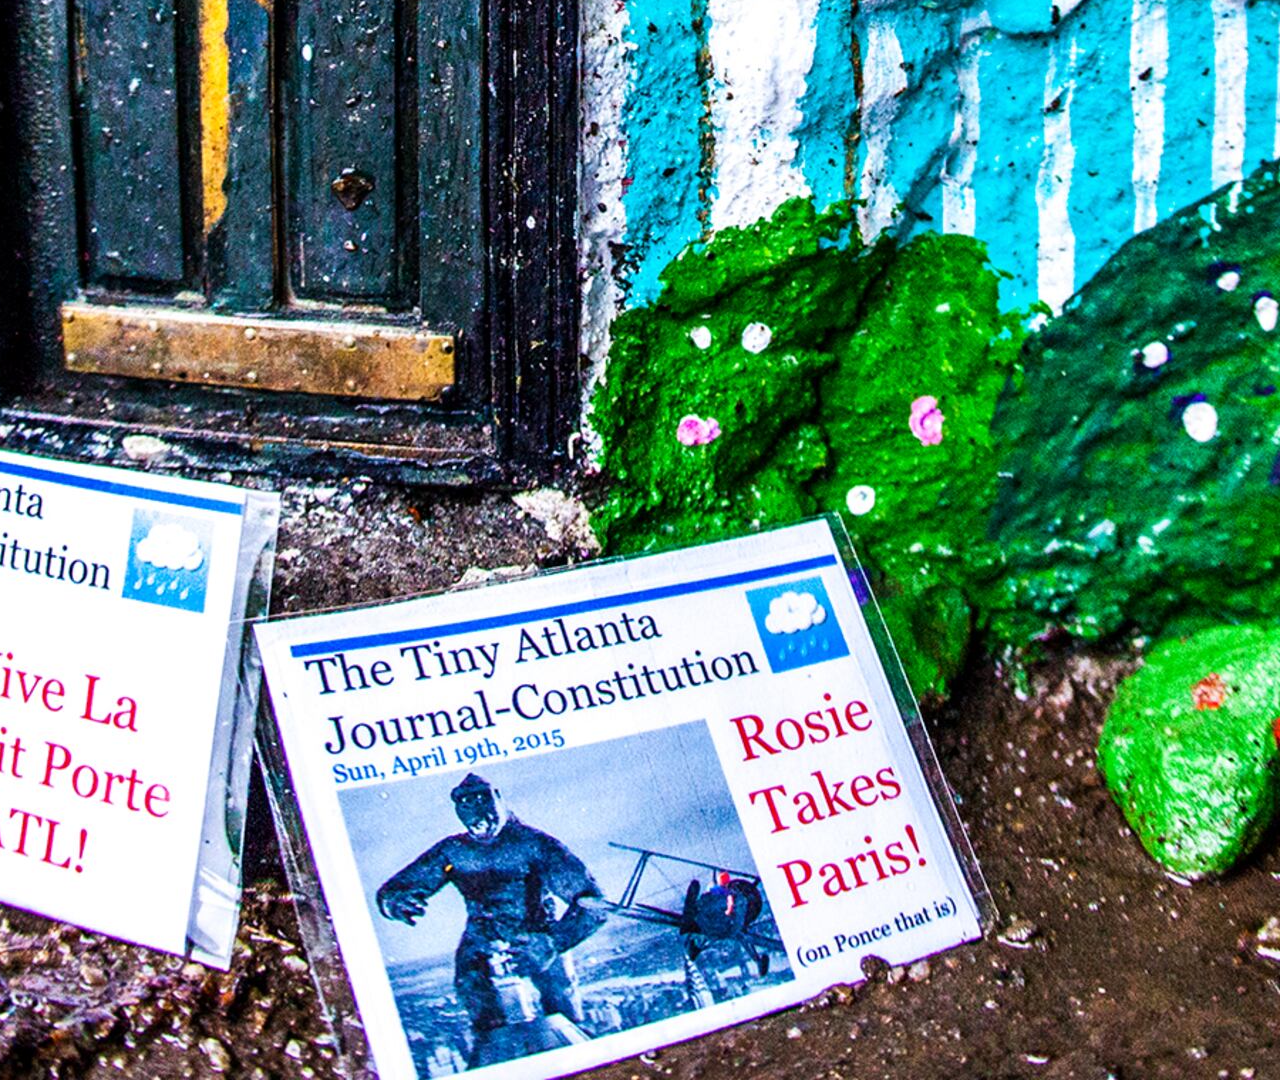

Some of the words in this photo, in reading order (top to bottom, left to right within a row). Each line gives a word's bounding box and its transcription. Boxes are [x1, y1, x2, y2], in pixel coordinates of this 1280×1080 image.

[304, 654, 395, 696] The
[400, 640, 502, 680] Tiny
[515, 609, 662, 665] Atlanta
[80, 674, 138, 732] La
[324, 649, 760, 756] Journal-Constitution
[729, 692, 874, 762] Rosie
[39, 741, 171, 818] Porte
[332, 760, 386, 784] Sun,
[392, 746, 448, 778] April
[455, 738, 509, 766] 19th,
[514, 728, 566, 752] 2015
[748, 766, 902, 834] Takes
[776, 824, 927, 909] Paris!
[796, 942, 832, 967] (on
[833, 923, 893, 954] Ponce
[893, 906, 933, 933] that
[932, 895, 958, 919] is)
